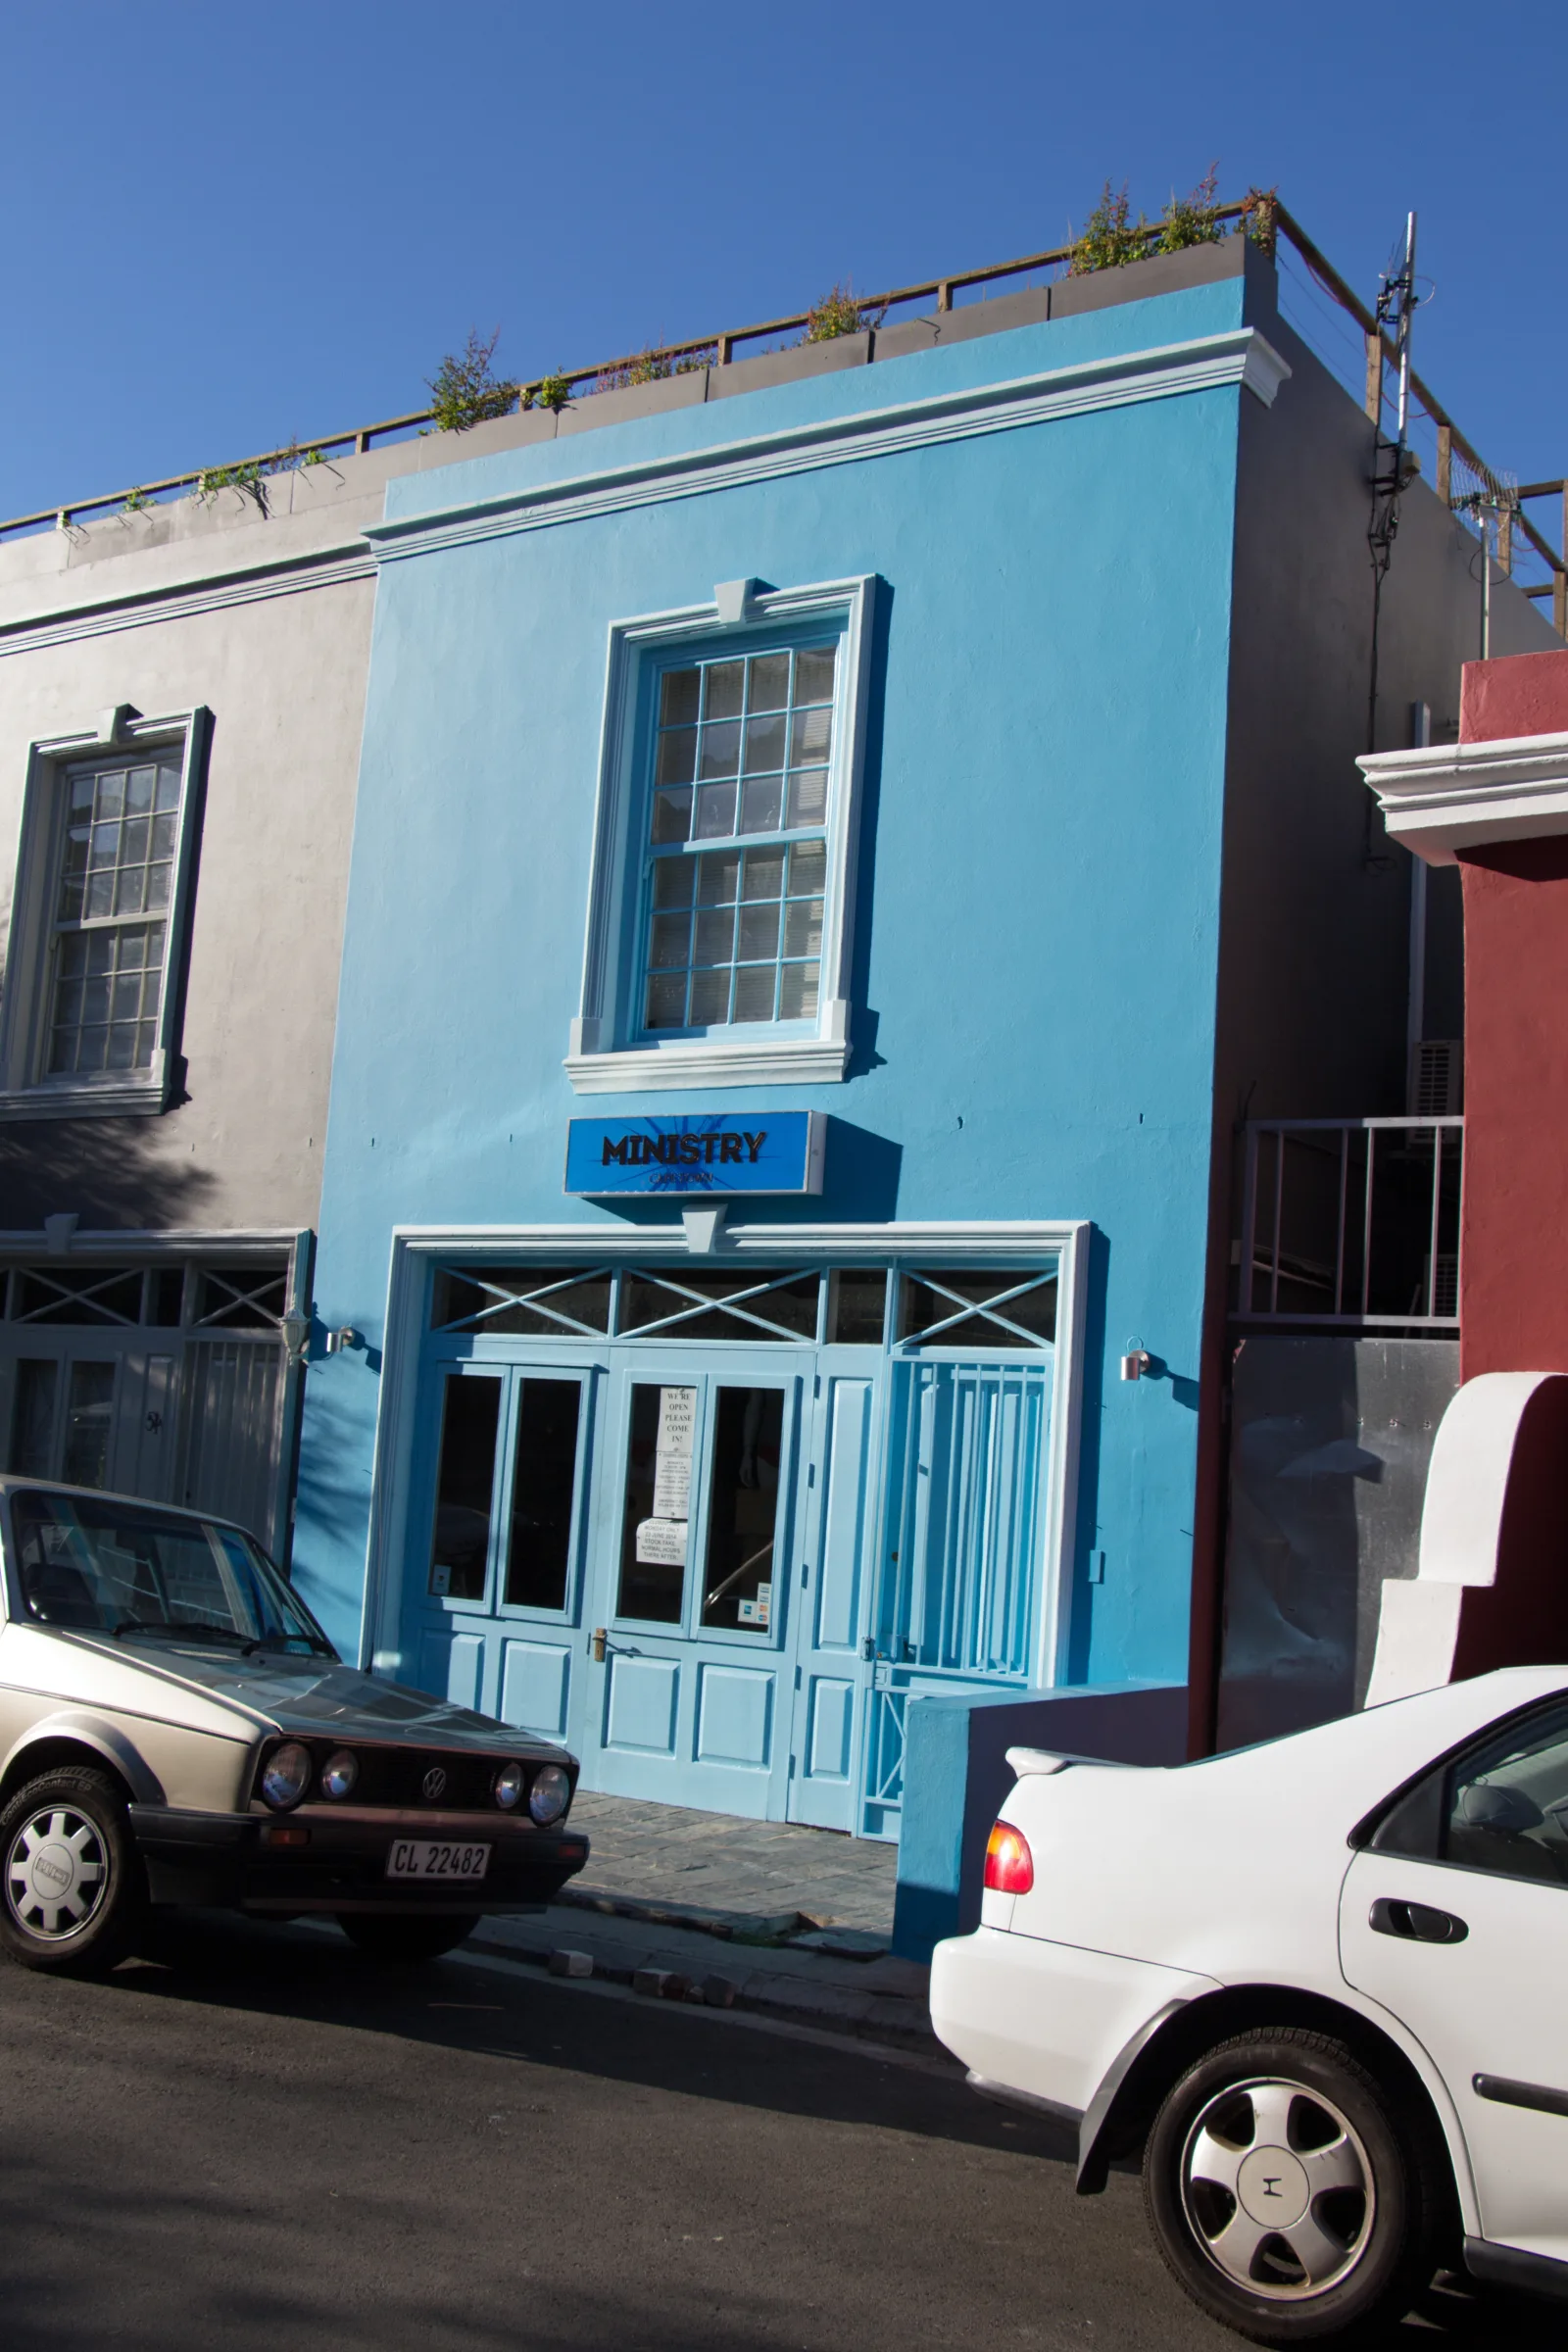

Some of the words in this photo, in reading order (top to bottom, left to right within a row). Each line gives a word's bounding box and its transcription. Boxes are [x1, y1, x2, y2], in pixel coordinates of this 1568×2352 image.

[601, 1131, 767, 1166] MINISTRY
[666, 1424, 690, 1433] COME
[641, 1544, 662, 1552] NORMAL
[394, 1844, 418, 1873] CL
[424, 1846, 485, 1875] 22482
